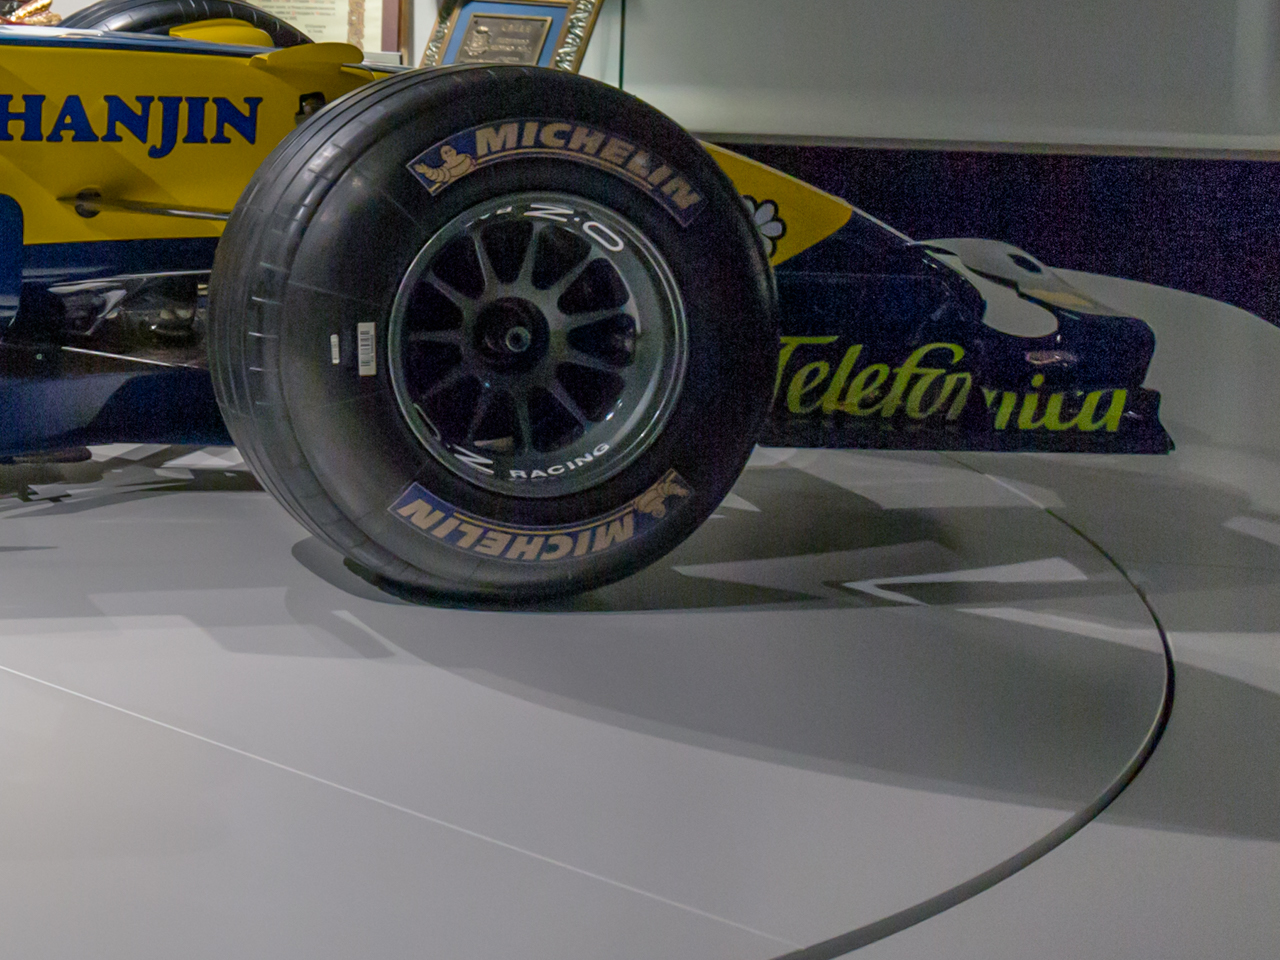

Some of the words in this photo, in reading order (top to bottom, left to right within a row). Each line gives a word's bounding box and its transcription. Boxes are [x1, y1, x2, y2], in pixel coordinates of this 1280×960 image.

[475, 122, 703, 212] MICHELIN
[509, 443, 610, 480] RACING
[397, 497, 634, 560] MICHELIN
